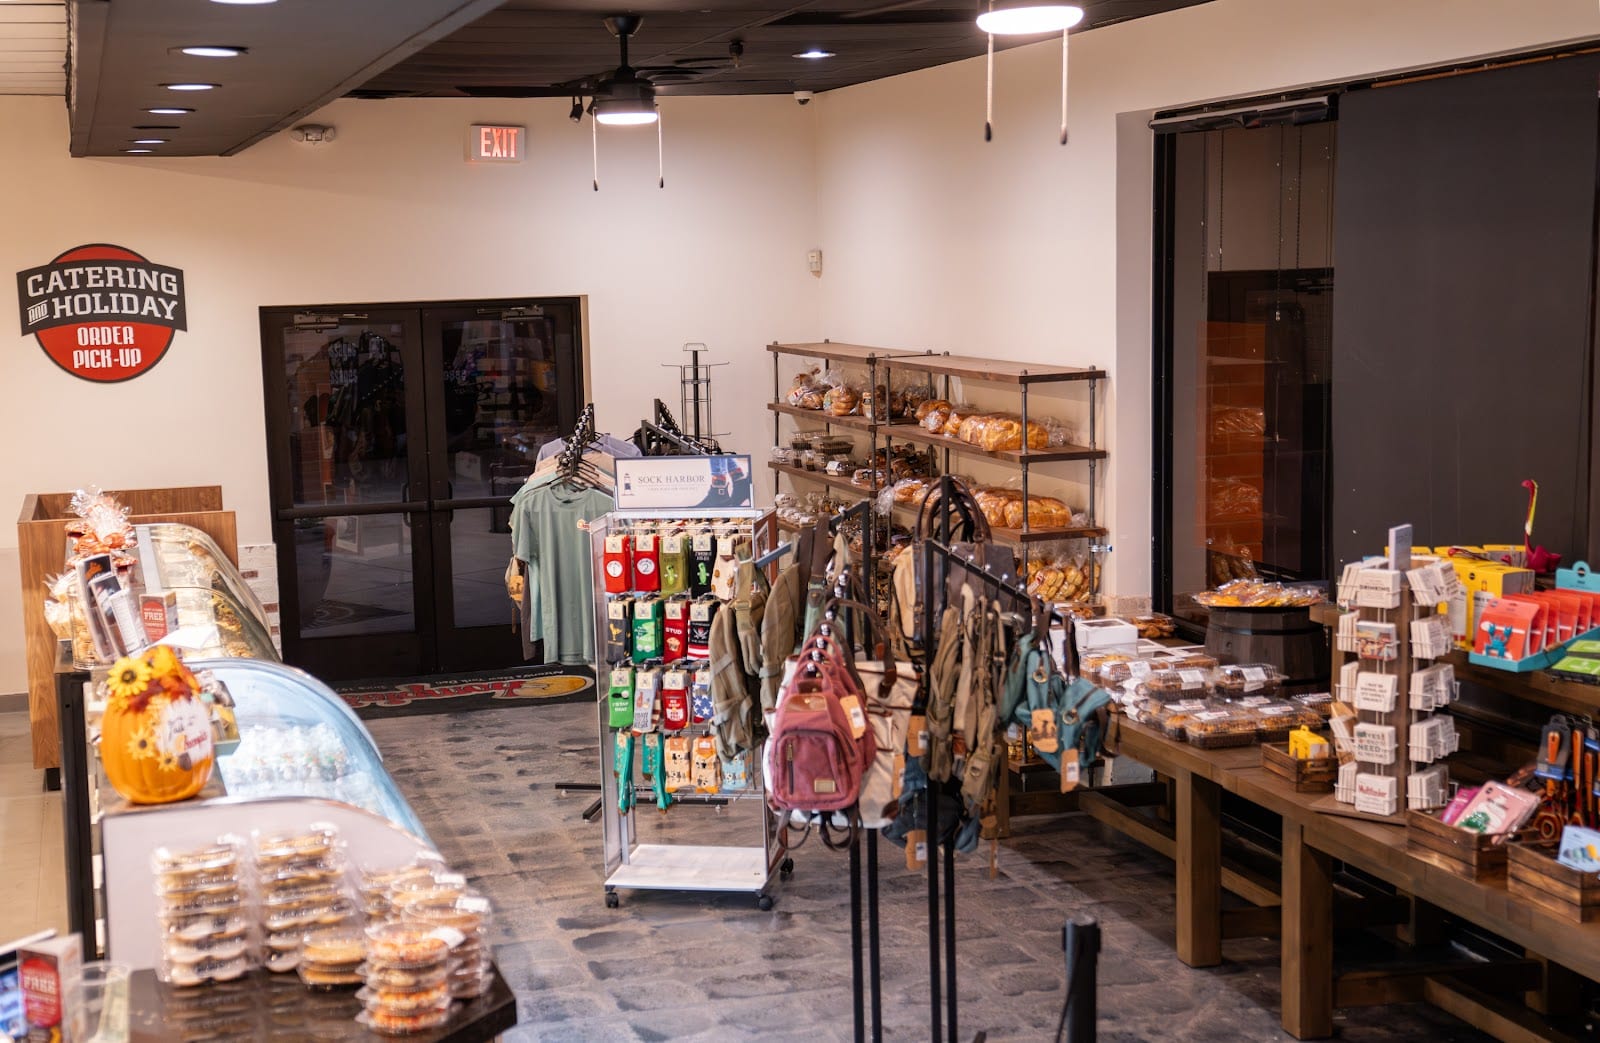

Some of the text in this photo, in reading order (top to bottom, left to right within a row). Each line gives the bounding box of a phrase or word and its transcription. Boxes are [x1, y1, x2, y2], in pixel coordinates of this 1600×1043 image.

[480, 127, 518, 158] EXIT
[27, 266, 178, 297] CATERING
[28, 292, 178, 323] AND HOLIDAY
[77, 326, 135, 346] ORDER
[73, 348, 142, 369] PICK-UP
[638, 474, 705, 484] SOCK HARBOR
[144, 611, 164, 621] FREE
[665, 627, 683, 635] STUD
[23, 975, 57, 996] FREE
